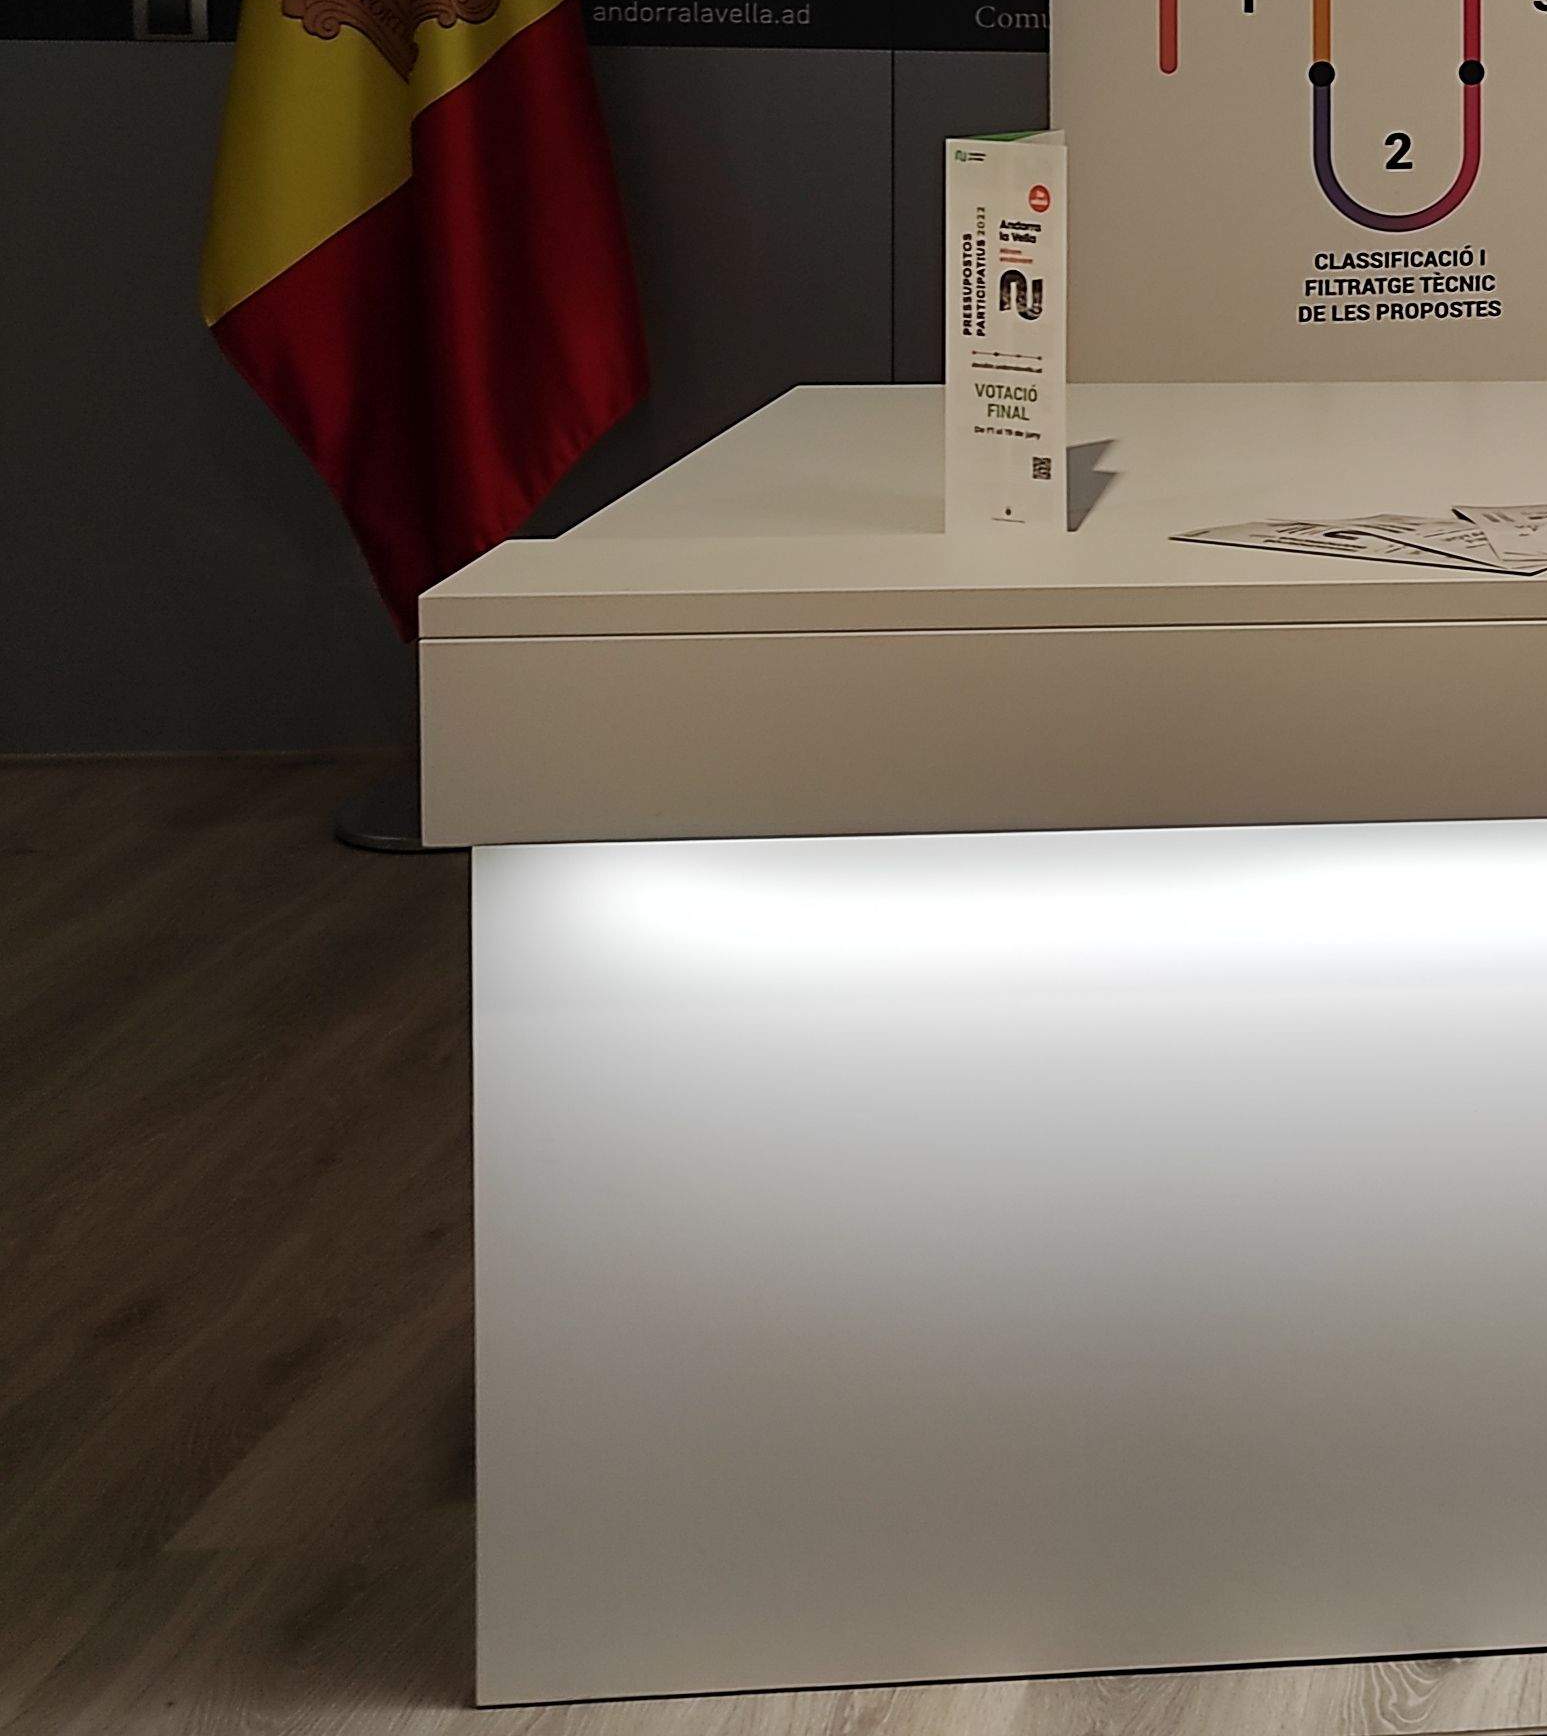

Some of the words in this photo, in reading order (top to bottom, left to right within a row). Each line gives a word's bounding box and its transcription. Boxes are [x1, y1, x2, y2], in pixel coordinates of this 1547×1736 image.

[592, 1, 811, 26] andorralavella.ad
[1384, 133, 1413, 170] 2
[1314, 247, 1477, 270] CLASSIFICACIÓ
[1480, 250, 1487, 267] I
[976, 239, 986, 337] PARTICIPATIUS
[1304, 274, 1415, 297] FILTRATGE
[1420, 271, 1496, 293] TÈCNIC
[1298, 303, 1326, 323] DE
[1332, 303, 1371, 322] LES
[1375, 300, 1502, 321] PROPOSTES
[974, 383, 1038, 402] VOTACIÓ
[987, 404, 1030, 421] FINAL
